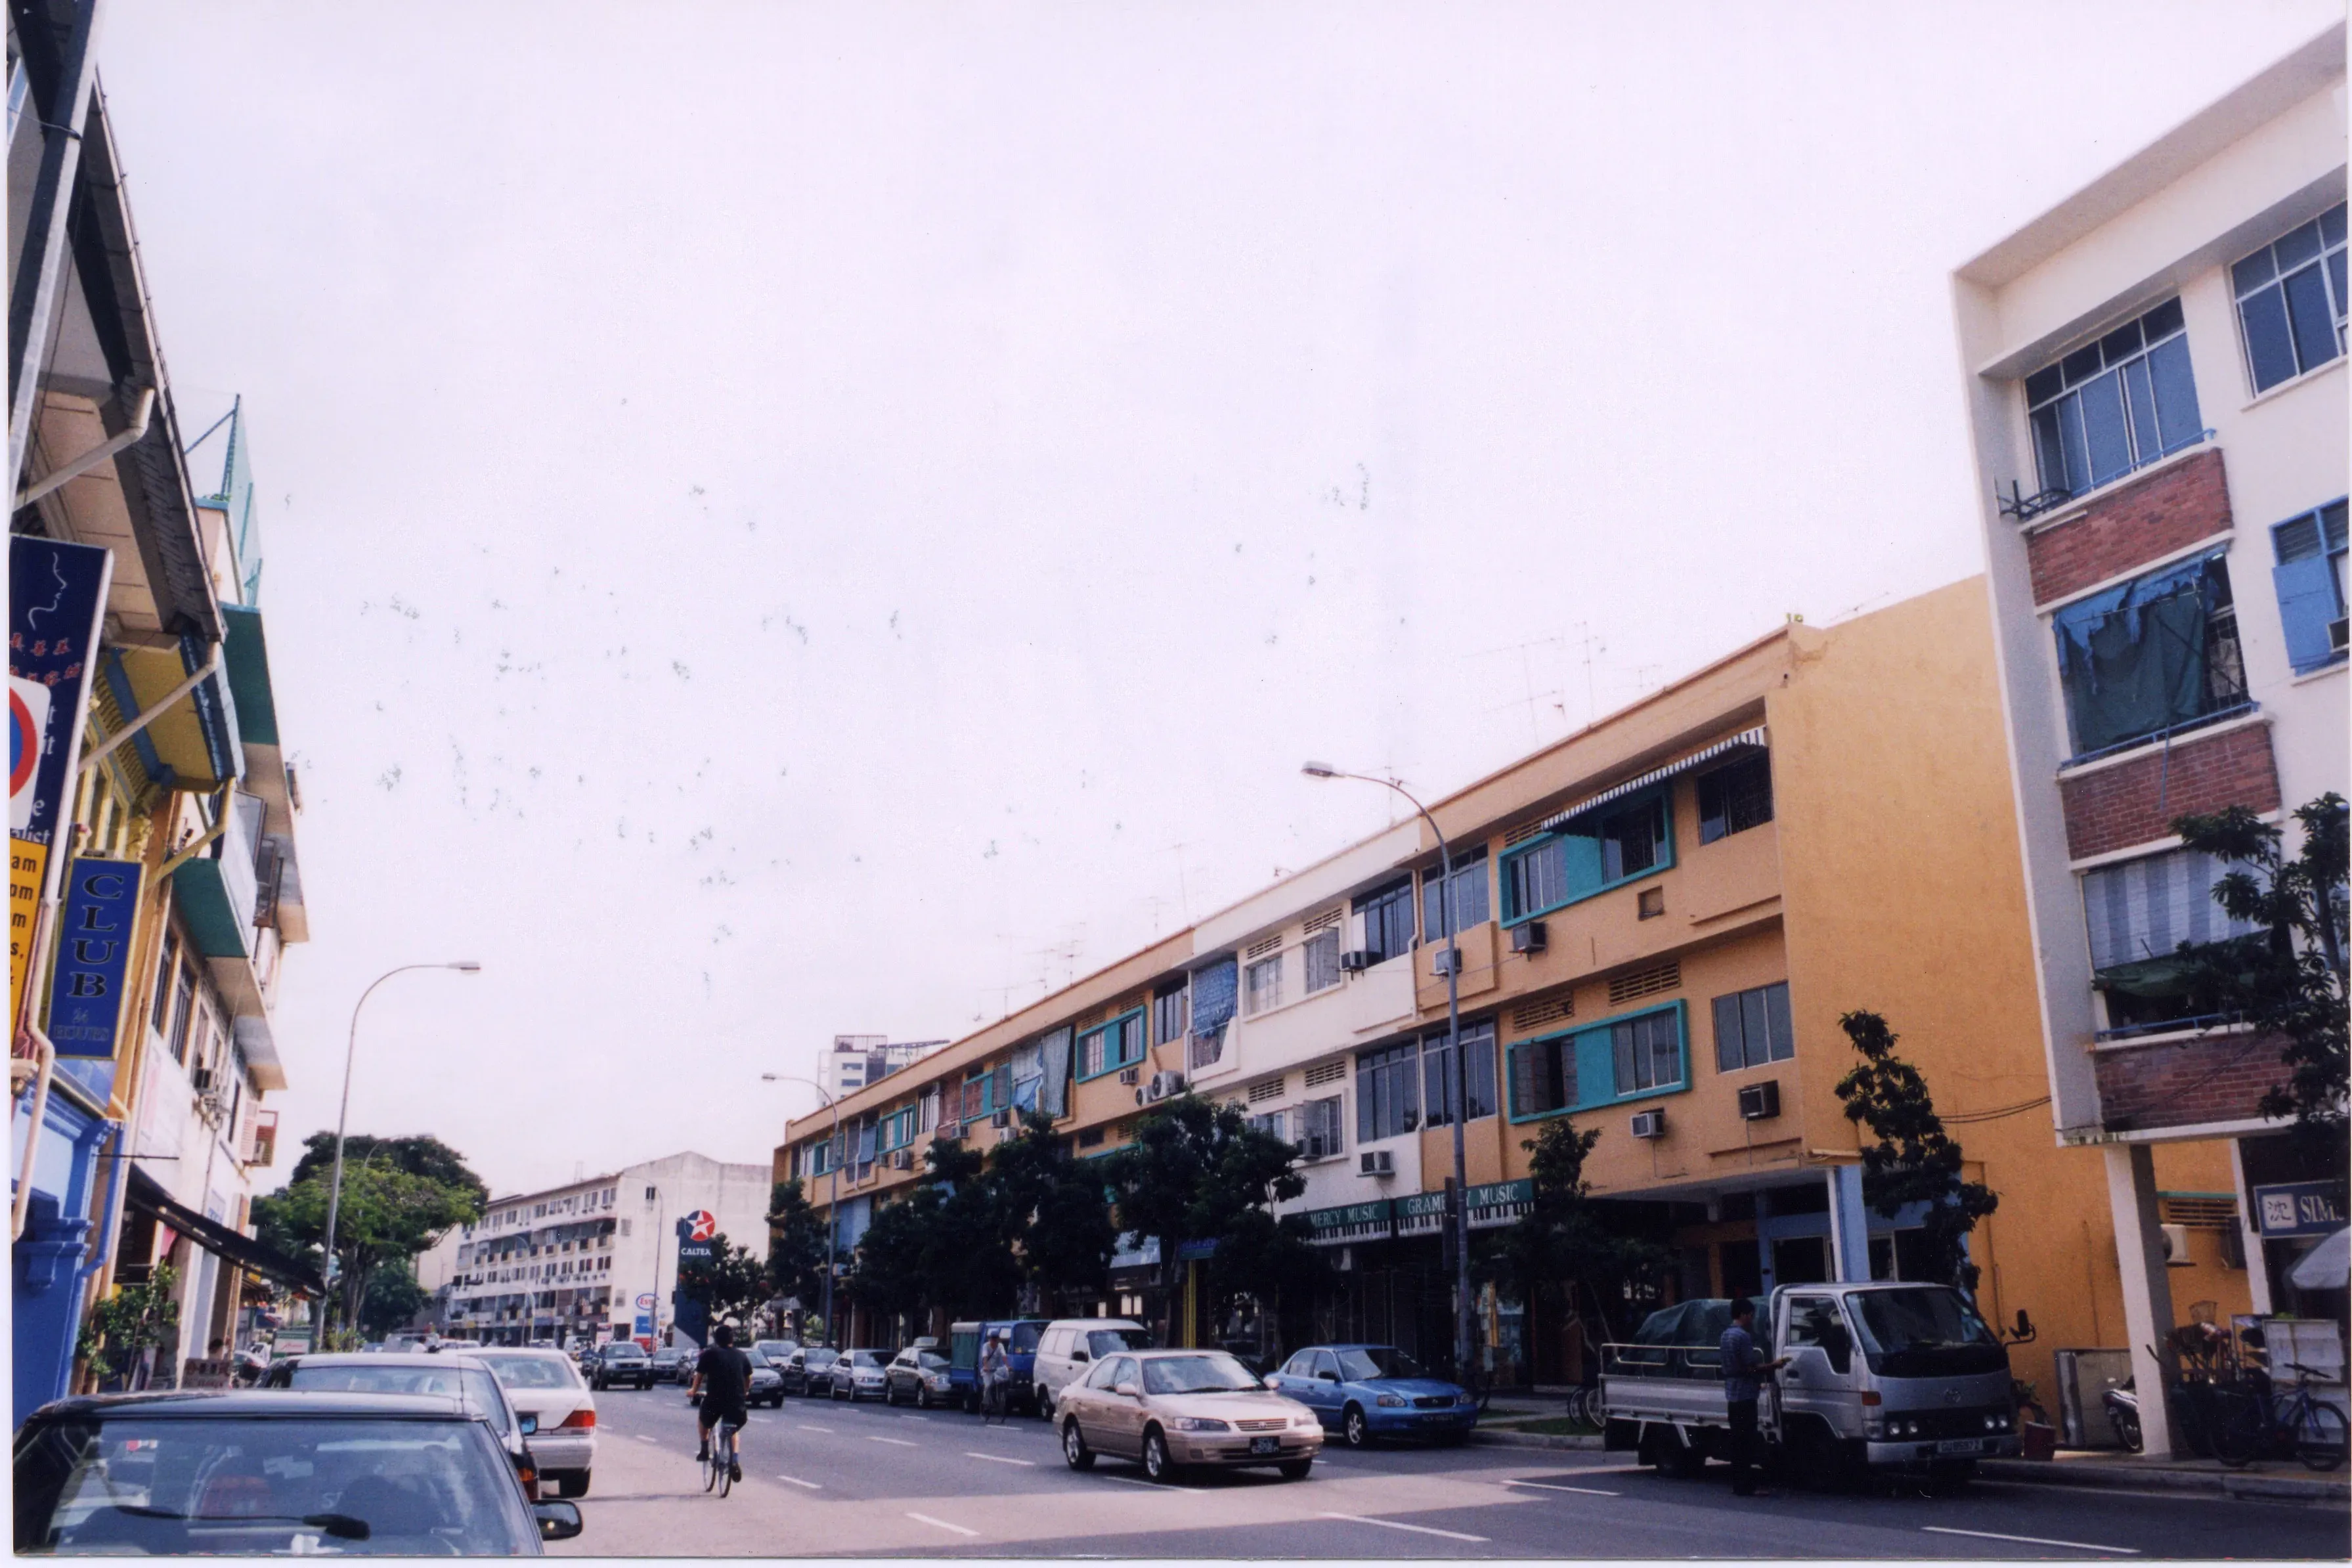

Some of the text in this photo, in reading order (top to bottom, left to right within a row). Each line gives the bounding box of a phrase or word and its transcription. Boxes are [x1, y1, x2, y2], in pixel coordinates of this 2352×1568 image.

[67, 873, 125, 997] CLUB
[1480, 1184, 1519, 1204] MUSIC
[1347, 1204, 1378, 1221] MUSIC
[681, 1247, 712, 1256] CALTEX
